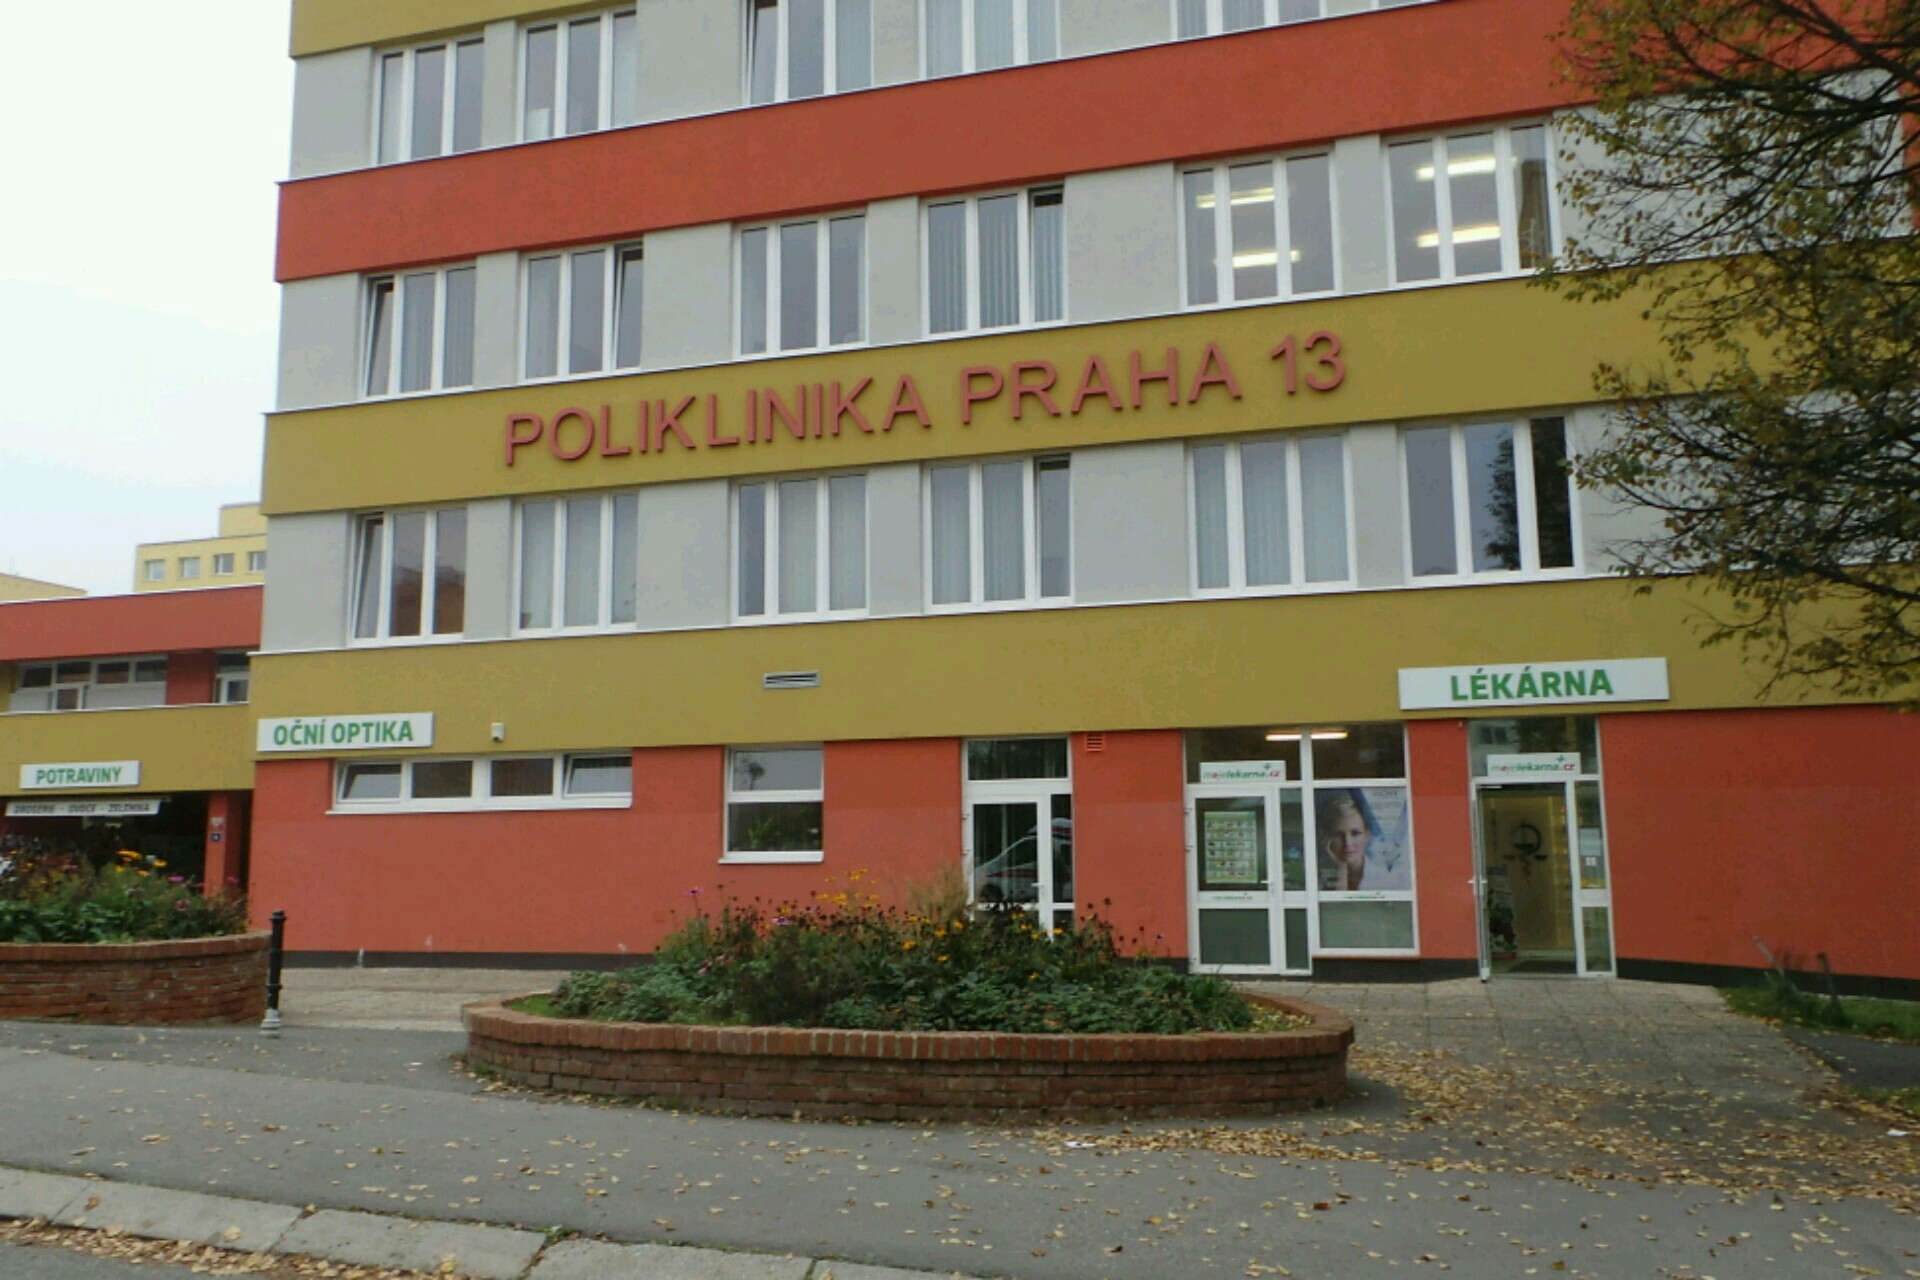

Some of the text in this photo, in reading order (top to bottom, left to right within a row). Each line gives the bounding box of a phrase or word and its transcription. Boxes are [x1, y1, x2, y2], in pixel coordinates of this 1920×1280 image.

[505, 331, 1346, 465] POLIKLINIKA PRAHA 13
[1451, 666, 1613, 701] LÉKÁRNA
[274, 719, 413, 746] OČNÍ OPTIKA
[36, 767, 122, 785] POTRAVINY
